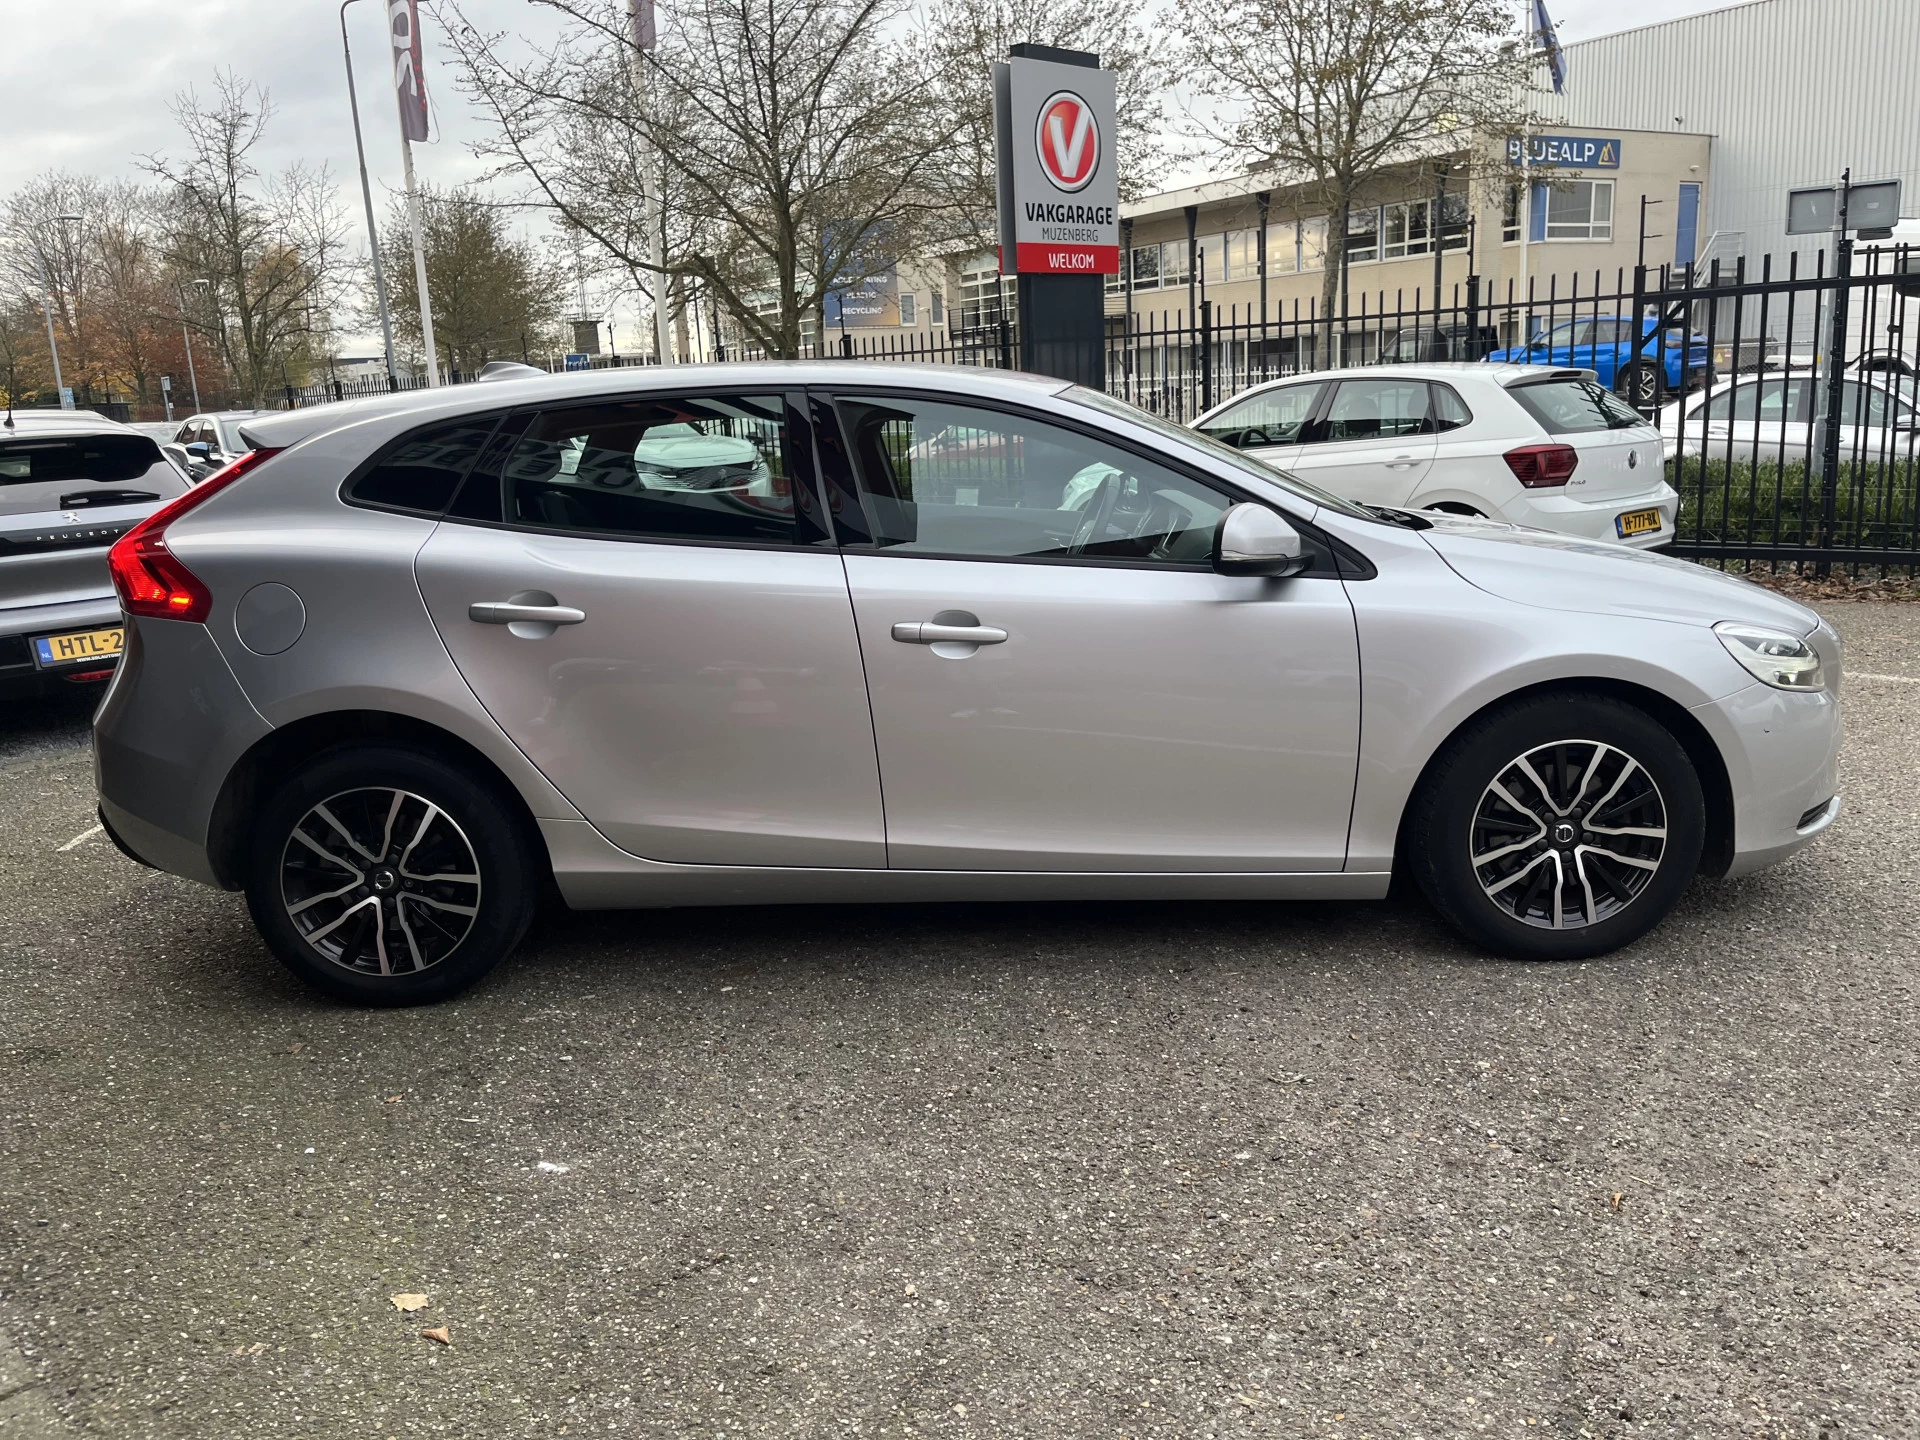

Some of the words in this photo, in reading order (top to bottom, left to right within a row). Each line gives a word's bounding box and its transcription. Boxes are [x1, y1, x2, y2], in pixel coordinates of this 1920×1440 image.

[1025, 202, 1113, 226] VAKGARAGE
[1042, 227, 1099, 243] MUZENBERG
[1048, 253, 1095, 269] WELKOM
[36, 528, 119, 541] PEUGEOT
